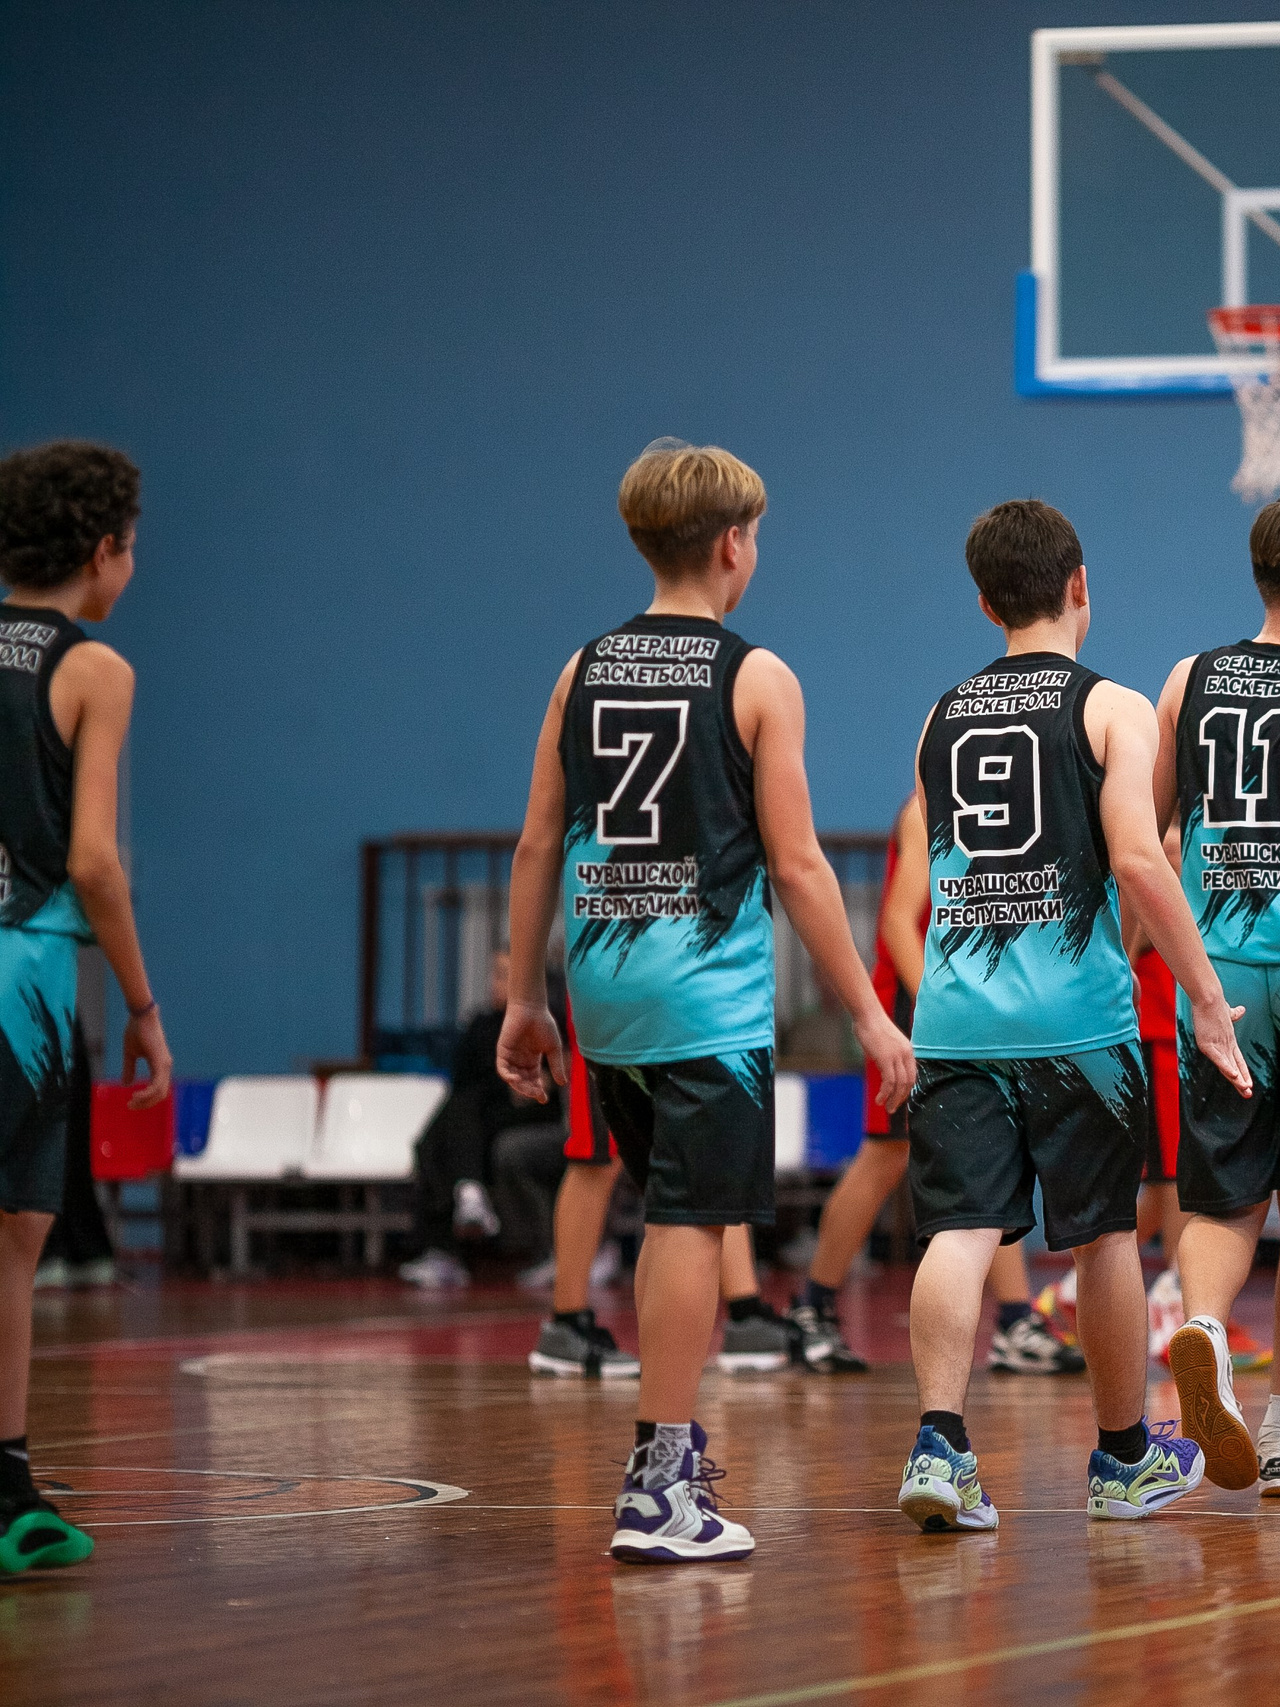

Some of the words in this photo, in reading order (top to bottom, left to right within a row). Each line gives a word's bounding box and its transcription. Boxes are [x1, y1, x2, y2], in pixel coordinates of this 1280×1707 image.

[596, 634, 720, 661] ФЕДЕРАЦИЯ
[585, 662, 712, 688] БАСКЕТБОЛА
[957, 670, 1071, 696] ФЕДЕРАЦИЯ
[945, 691, 1061, 719] БАСКЕТБОЛА
[593, 700, 689, 844] 7
[951, 724, 1042, 858] 9
[576, 855, 698, 886] ЧУВАШСКОЙ
[938, 864, 1059, 898] ЧУВАШСКОЙ
[573, 893, 700, 919] РЕСПУБЛИКИ
[936, 899, 1063, 927] РЕСПУБЛИКИ
